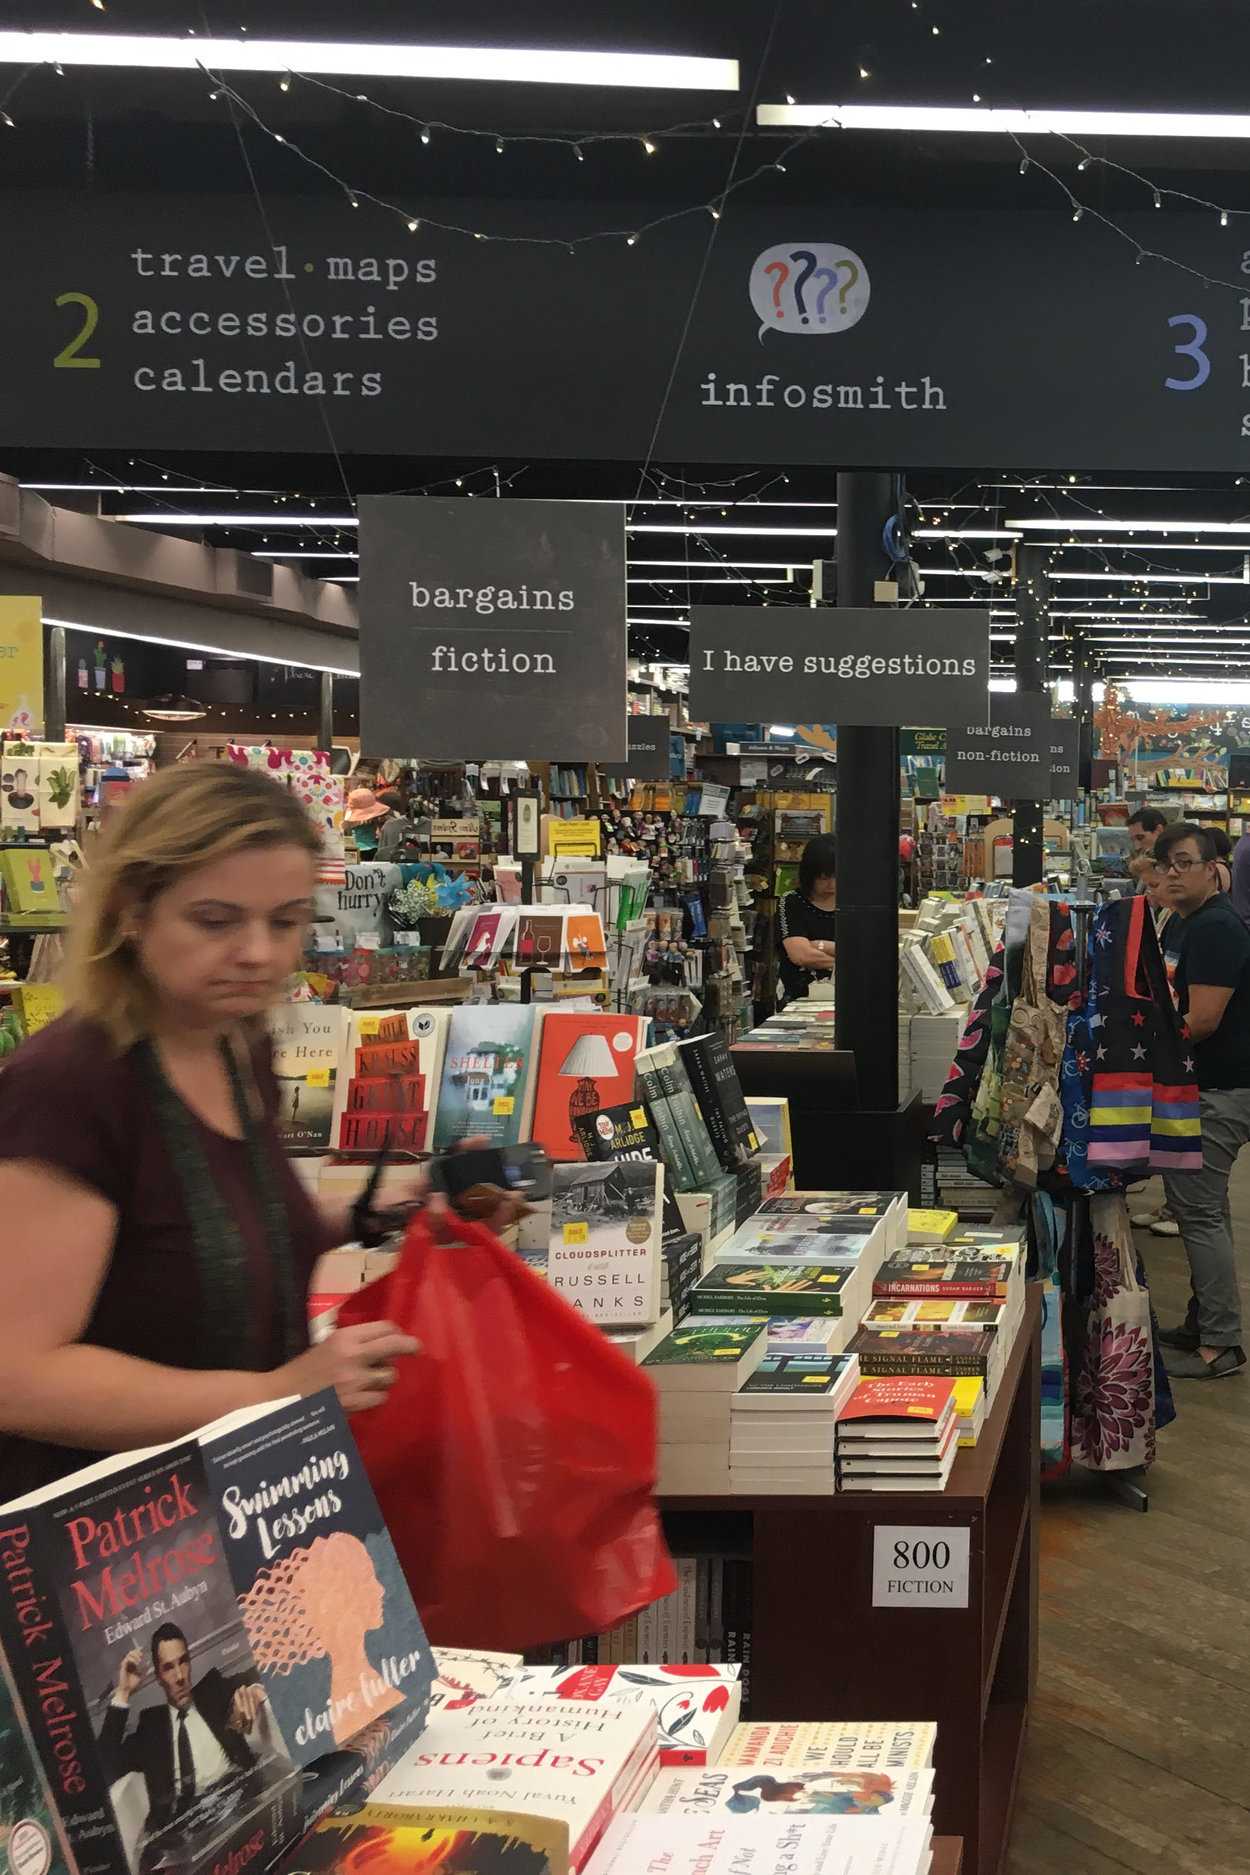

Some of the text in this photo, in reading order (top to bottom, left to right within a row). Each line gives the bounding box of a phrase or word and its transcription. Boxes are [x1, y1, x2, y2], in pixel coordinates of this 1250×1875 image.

[132, 246, 439, 287] travel maps
[53, 293, 101, 369] 2
[132, 305, 440, 342] accessories
[1164, 314, 1210, 390] 3
[133, 360, 384, 397] calendars
[700, 373, 947, 410] infosmith
[409, 582, 575, 614] bargains
[432, 646, 556, 673] fiction
[702, 650, 976, 679] I have suggestions
[957, 750, 1040, 763] non-fiction
[345, 868, 387, 891] Don't
[337, 891, 383, 916] hurry
[303, 1022, 331, 1034] You
[295, 1046, 333, 1058] Here
[451, 1056, 525, 1069] SHELTER
[643, 1073, 658, 1099] Colm
[660, 1068, 675, 1093] Colm
[345, 1118, 423, 1147] HOUSE
[610, 1132, 646, 1150] ARLIDGE
[555, 1249, 646, 1259] CLOUDSPLITTER
[554, 1273, 645, 1287] RUSSELL
[888, 1283, 940, 1293] INCARNATIONS
[573, 1295, 643, 1308] ANKS
[872, 1366, 907, 1374] SIGNAL
[873, 1355, 907, 1363] SIGNAL
[222, 1450, 349, 1539] Swimming
[65, 1473, 198, 1570] Patrick
[257, 1487, 342, 1559] Lessons
[893, 1541, 951, 1569] 800
[71, 1531, 217, 1632] Melrose
[887, 1580, 954, 1593] FICTION
[104, 1604, 152, 1645] Edward
[171, 1579, 209, 1614] Aubyn
[0, 1525, 86, 1795] Patrick Melrose
[727, 1631, 736, 1663] RAIN
[742, 1633, 751, 1704] RAIN DOGS
[295, 1649, 421, 1746] claire fuller
[466, 1715, 605, 1732] History of
[467, 1706, 622, 1720] Humankind
[477, 1730, 575, 1743] A Brief
[773, 1724, 799, 1756] ADICHIE
[413, 1749, 605, 1777] Sapiens
[805, 1746, 829, 1762] WE
[857, 1738, 885, 1768] ALL BE
[388, 1789, 577, 1805] Yuval Noah Harari
[703, 1830, 725, 1855] Art
[648, 1850, 674, 1873] The
[735, 1847, 757, 1867] Not
